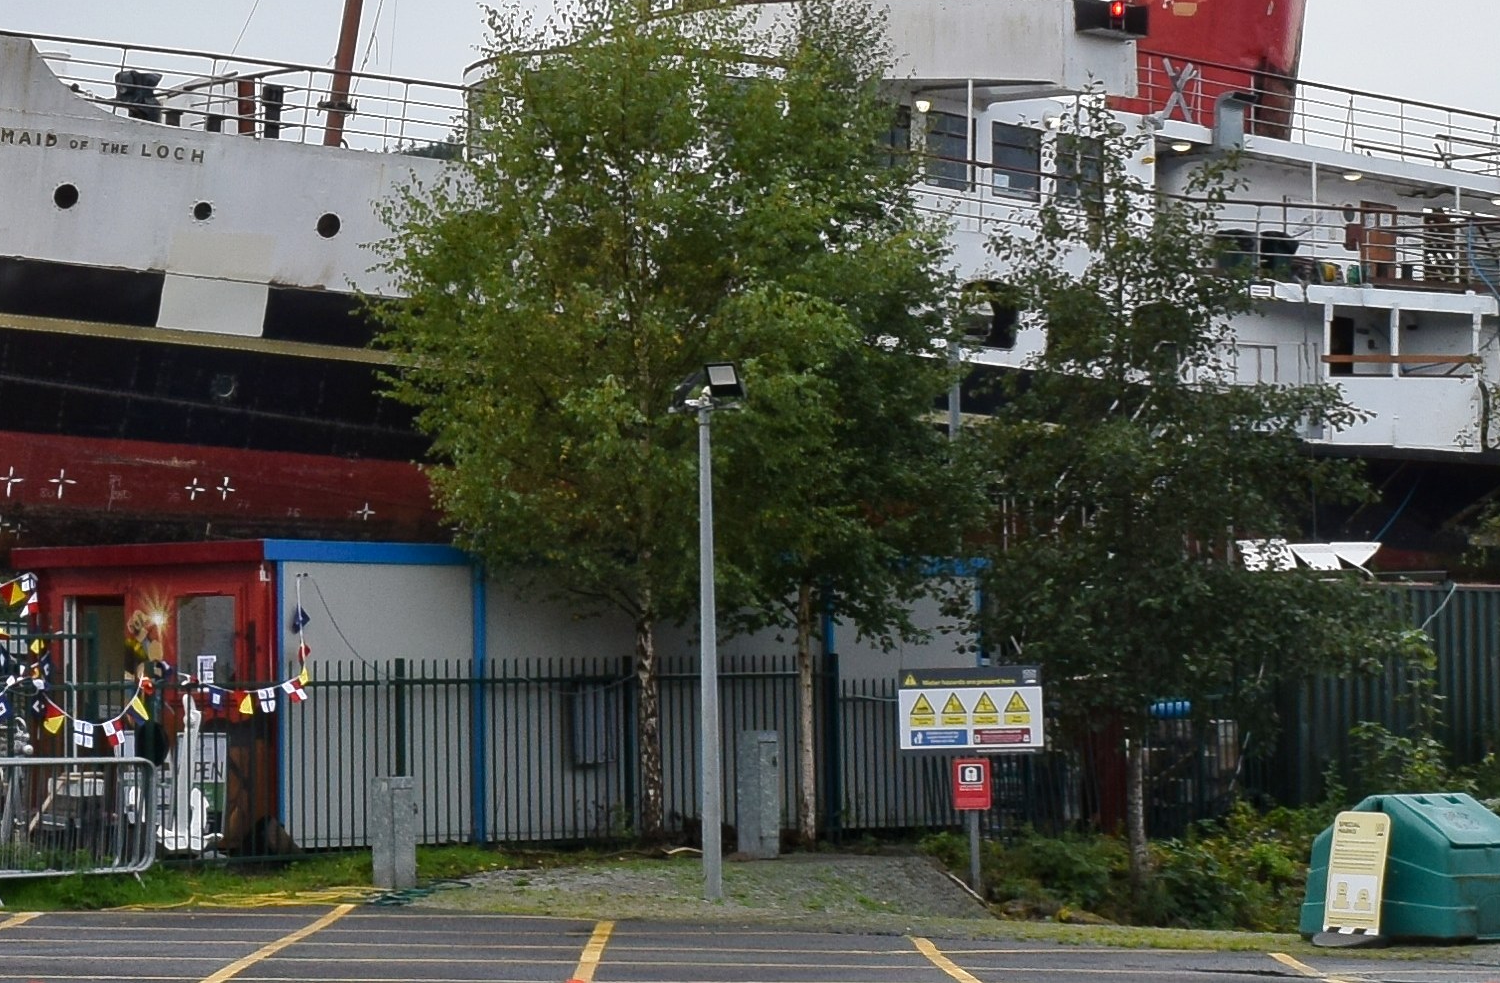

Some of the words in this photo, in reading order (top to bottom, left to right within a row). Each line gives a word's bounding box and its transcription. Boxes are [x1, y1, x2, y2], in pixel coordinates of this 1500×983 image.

[0, 127, 58, 147] MAID
[69, 139, 89, 150] OF
[100, 142, 129, 155] THE
[141, 144, 205, 164] LOCH
